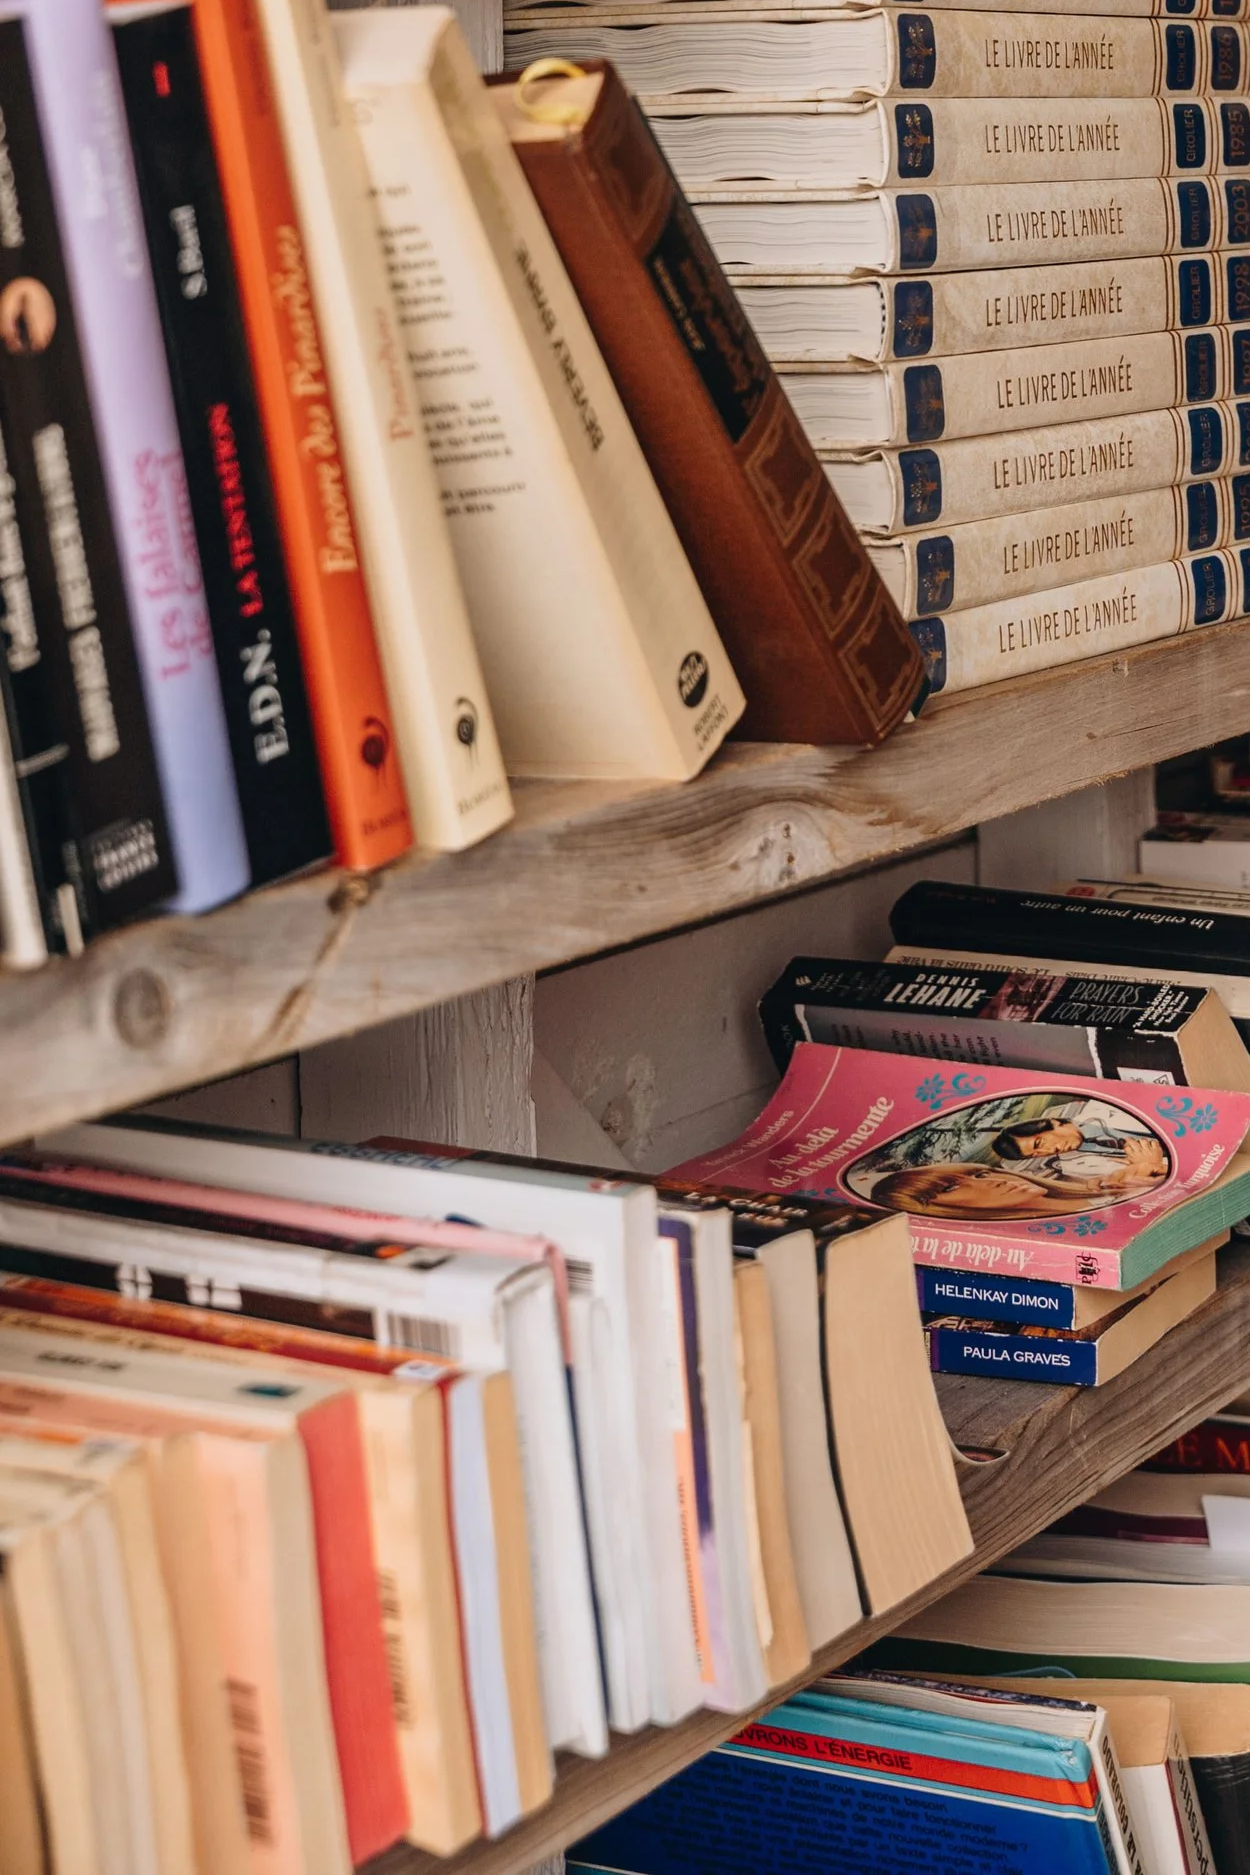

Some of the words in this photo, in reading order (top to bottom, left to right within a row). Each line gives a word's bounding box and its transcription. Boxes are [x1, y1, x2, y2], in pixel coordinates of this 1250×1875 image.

[985, 38, 999, 68] LE
[1005, 39, 1042, 69] LIVRE
[1046, 41, 1061, 70] DE
[1065, 33, 1114, 70] L'ANNÉE
[985, 124, 1001, 153] LE
[1006, 124, 1044, 153] LIVRE
[1049, 124, 1064, 152] DE
[1069, 115, 1121, 151] L'ANNÉE
[1229, 110, 1243, 159] 1985
[987, 213, 1003, 243] LE
[1008, 212, 1047, 241] LIVRE
[1050, 209, 1067, 239] DE
[1072, 198, 1124, 237] L'ANNÉE
[1233, 185, 1248, 238] 2003
[986, 298, 1001, 327] LE
[1007, 296, 1047, 325] LIVRE
[1051, 293, 1066, 320] DE
[1071, 278, 1123, 318] L'ANNÉE
[551, 337, 605, 452] BEVERLY
[997, 379, 1013, 408] LE
[1018, 373, 1058, 403] LIVRE
[1061, 370, 1077, 399] DE
[1081, 356, 1133, 397] L'ANNÉE
[993, 459, 1010, 489] LE
[1015, 453, 1056, 485] LIVRE
[1059, 449, 1076, 478] DE
[1080, 433, 1134, 475] L'ANNÉE
[1019, 899, 1061, 912] autre
[1065, 904, 1086, 913] un
[1091, 904, 1130, 919] pour
[1133, 912, 1186, 925] enfant
[1190, 918, 1214, 929] Un
[884, 983, 987, 1011] LEHANE
[915, 973, 979, 988] DENNIS
[1070, 981, 1146, 1005] PRAYERS
[768, 1176, 795, 1189] de
[811, 1096, 895, 1169] tourmente
[768, 1125, 839, 1169] Au-delà
[1178, 1143, 1225, 1193] Turquoise
[922, 1237, 939, 1260] la
[941, 1240, 963, 1262] de
[964, 1246, 1034, 1272] Au-delà
[934, 1282, 1010, 1306] HELENKAY
[1011, 1293, 1059, 1311] DIMON
[962, 1345, 1011, 1362] PAULA
[1013, 1351, 1071, 1368] GRAVES
[1102, 1735, 1129, 1833] COLORADO
